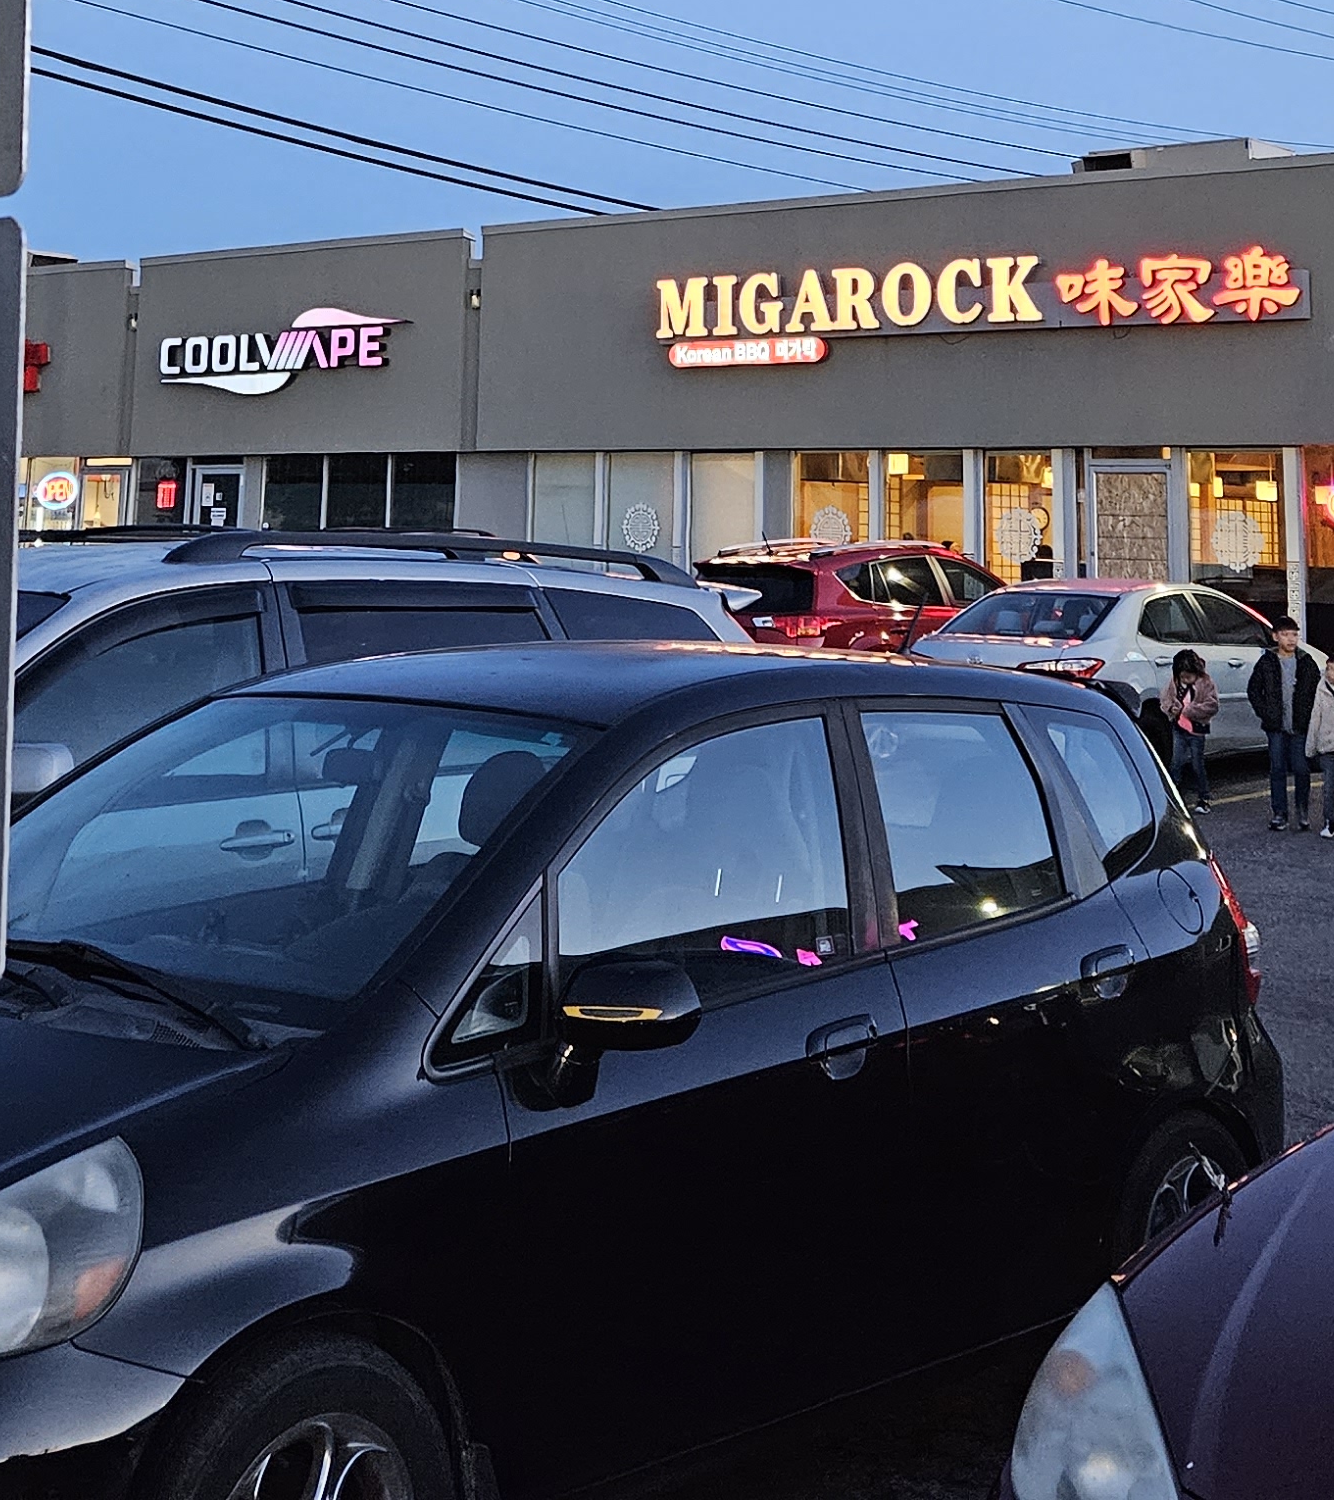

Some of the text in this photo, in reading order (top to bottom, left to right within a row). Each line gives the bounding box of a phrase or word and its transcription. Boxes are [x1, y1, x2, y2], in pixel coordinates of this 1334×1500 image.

[655, 255, 1043, 339] MIGAROCK
[1054, 245, 1301, 326] 味家樂
[676, 342, 770, 364] Korean BBQ
